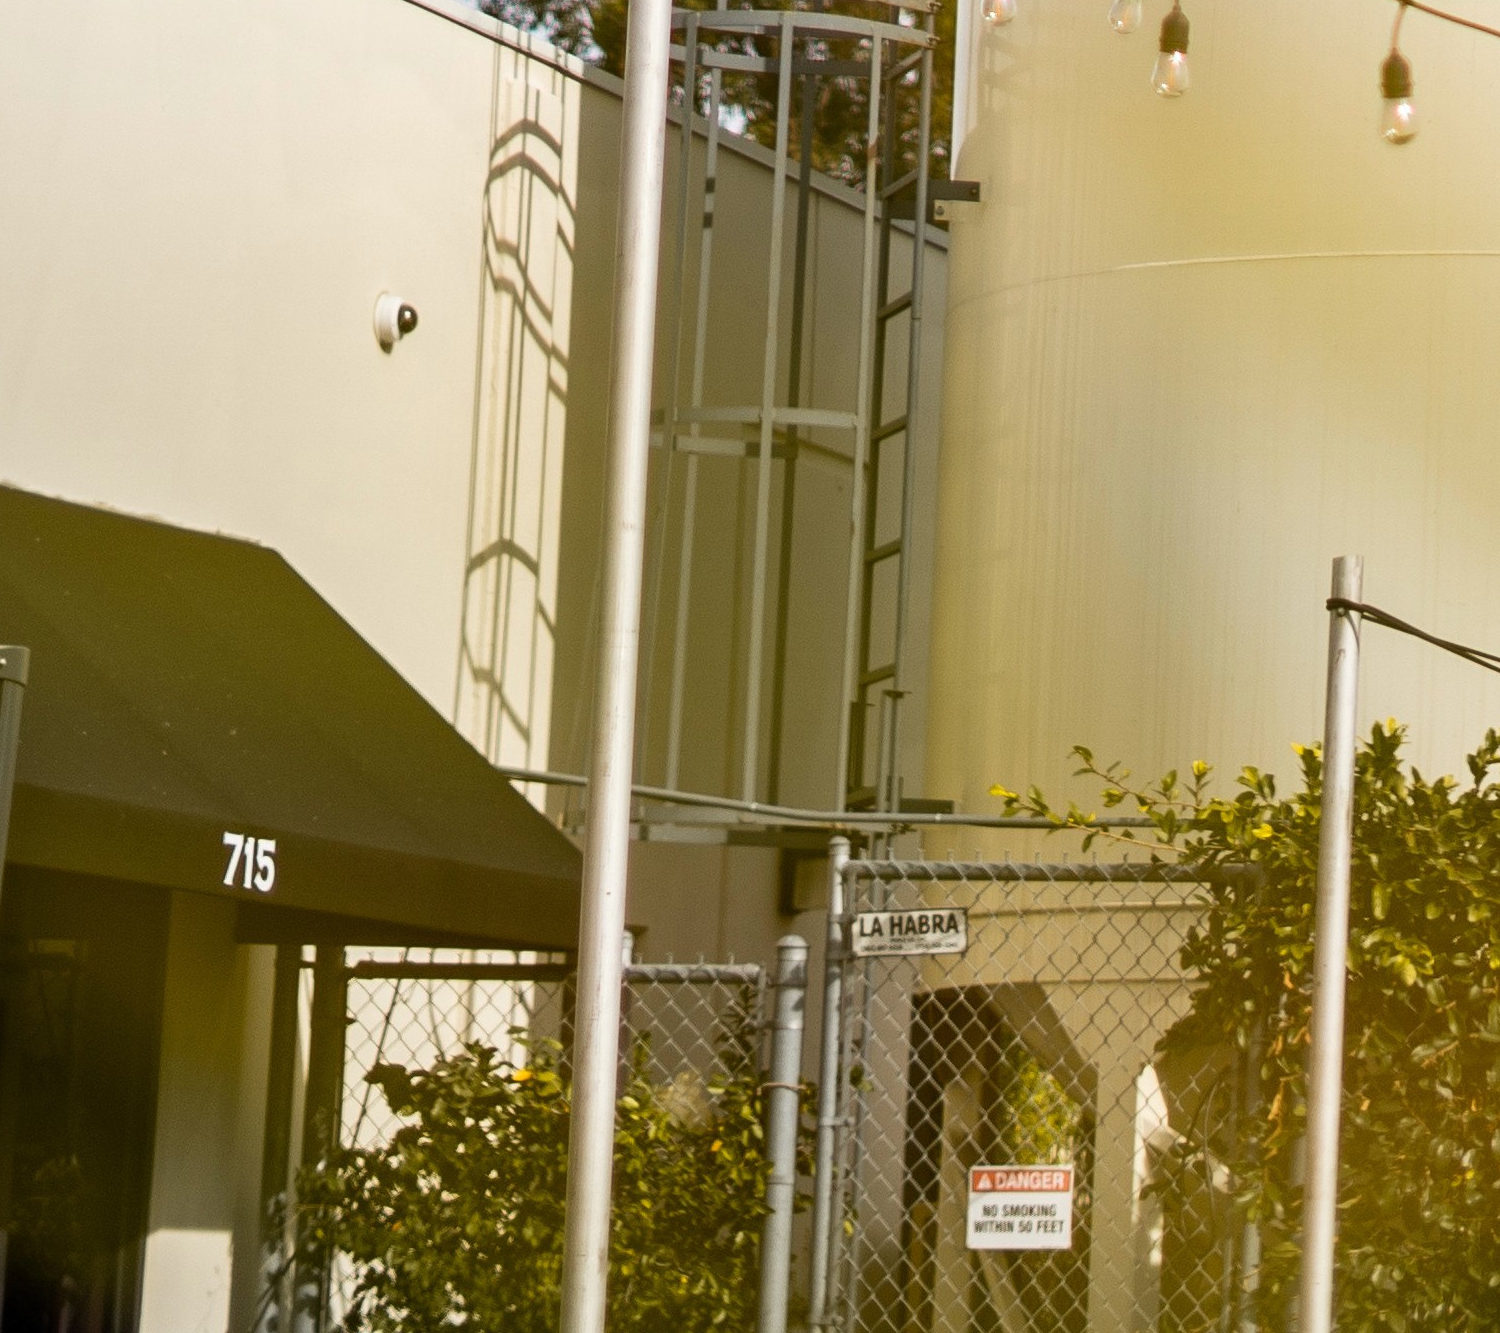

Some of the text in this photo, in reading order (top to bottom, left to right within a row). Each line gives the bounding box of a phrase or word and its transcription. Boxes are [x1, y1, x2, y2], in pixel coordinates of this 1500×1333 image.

[222, 831, 277, 893] 715
[859, 913, 960, 938] LA HABRA
[995, 1171, 1065, 1190] DANGER
[982, 1204, 1057, 1217] NO SMOKING
[973, 1219, 1065, 1233] WITHIN 50 FEET
